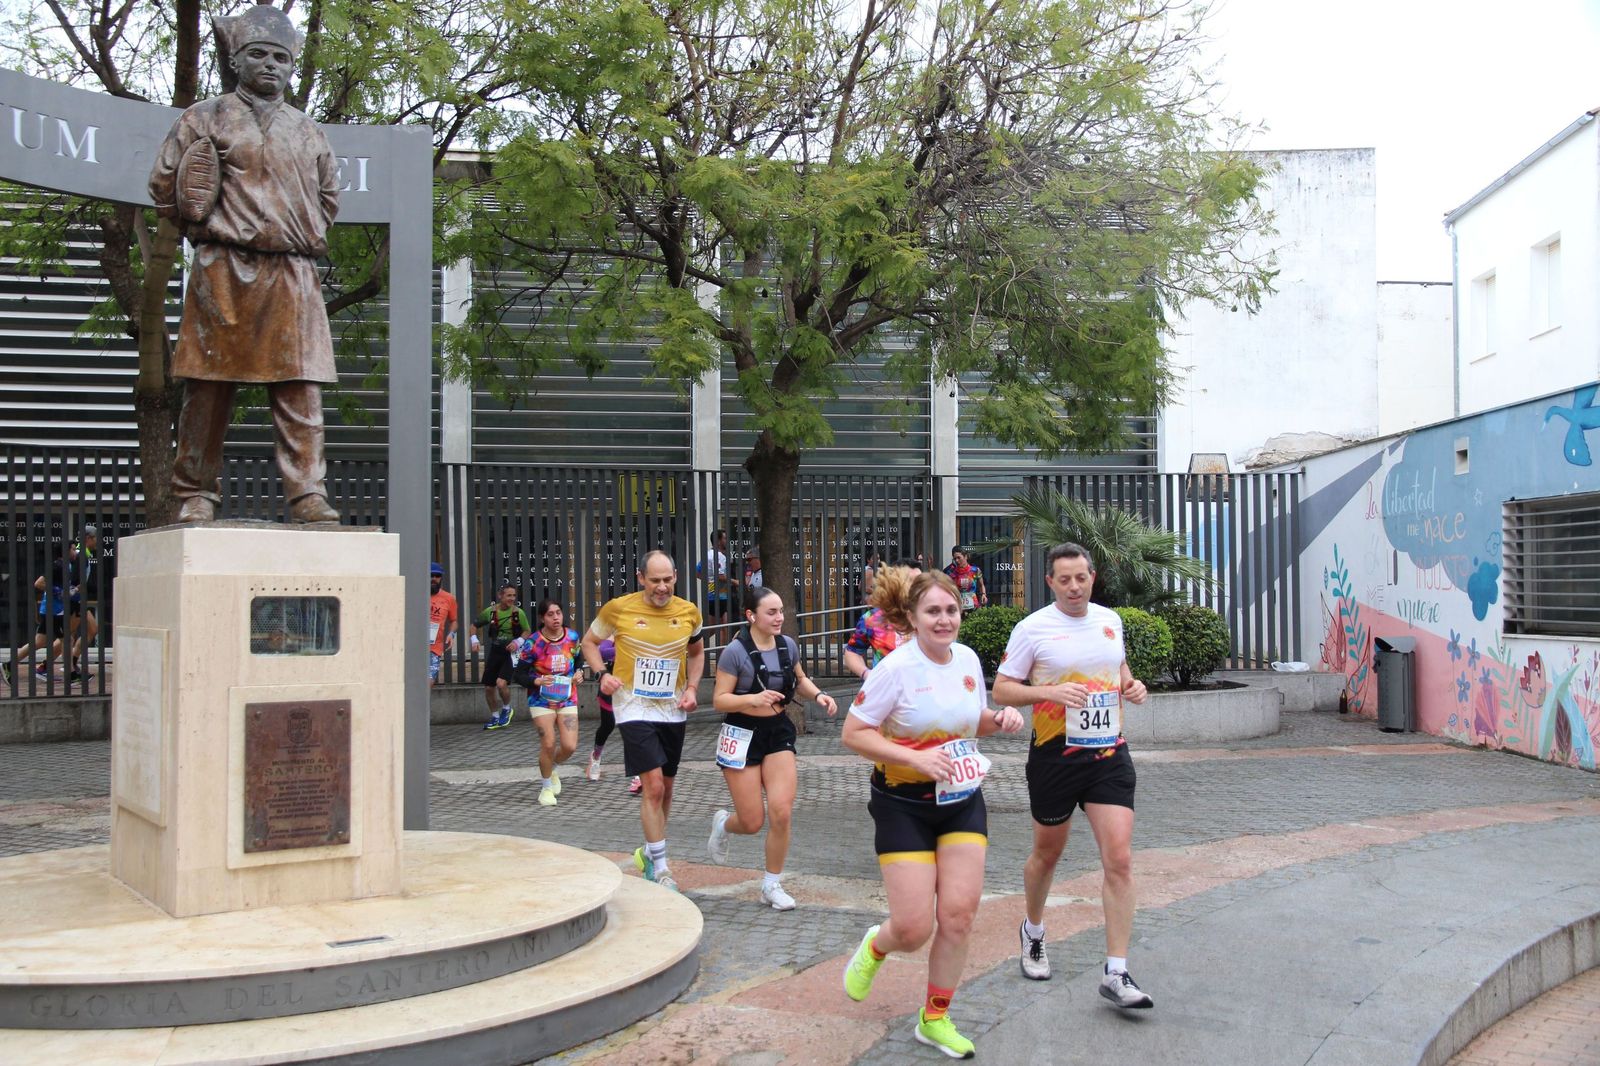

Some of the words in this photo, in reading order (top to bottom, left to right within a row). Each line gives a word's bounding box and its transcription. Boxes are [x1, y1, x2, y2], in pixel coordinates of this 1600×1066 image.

[0, 103, 101, 164] UM
[334, 155, 372, 192] EI
[1384, 466, 1437, 521] libertad
[1424, 512, 1467, 547] nace
[995, 562, 1025, 571] ISRAE
[641, 670, 671, 687] 1071
[1080, 708, 1110, 730] 344
[28, 991, 187, 1018] GLORIA
[224, 981, 304, 1010] DEL
[335, 949, 491, 998] SANTERO
